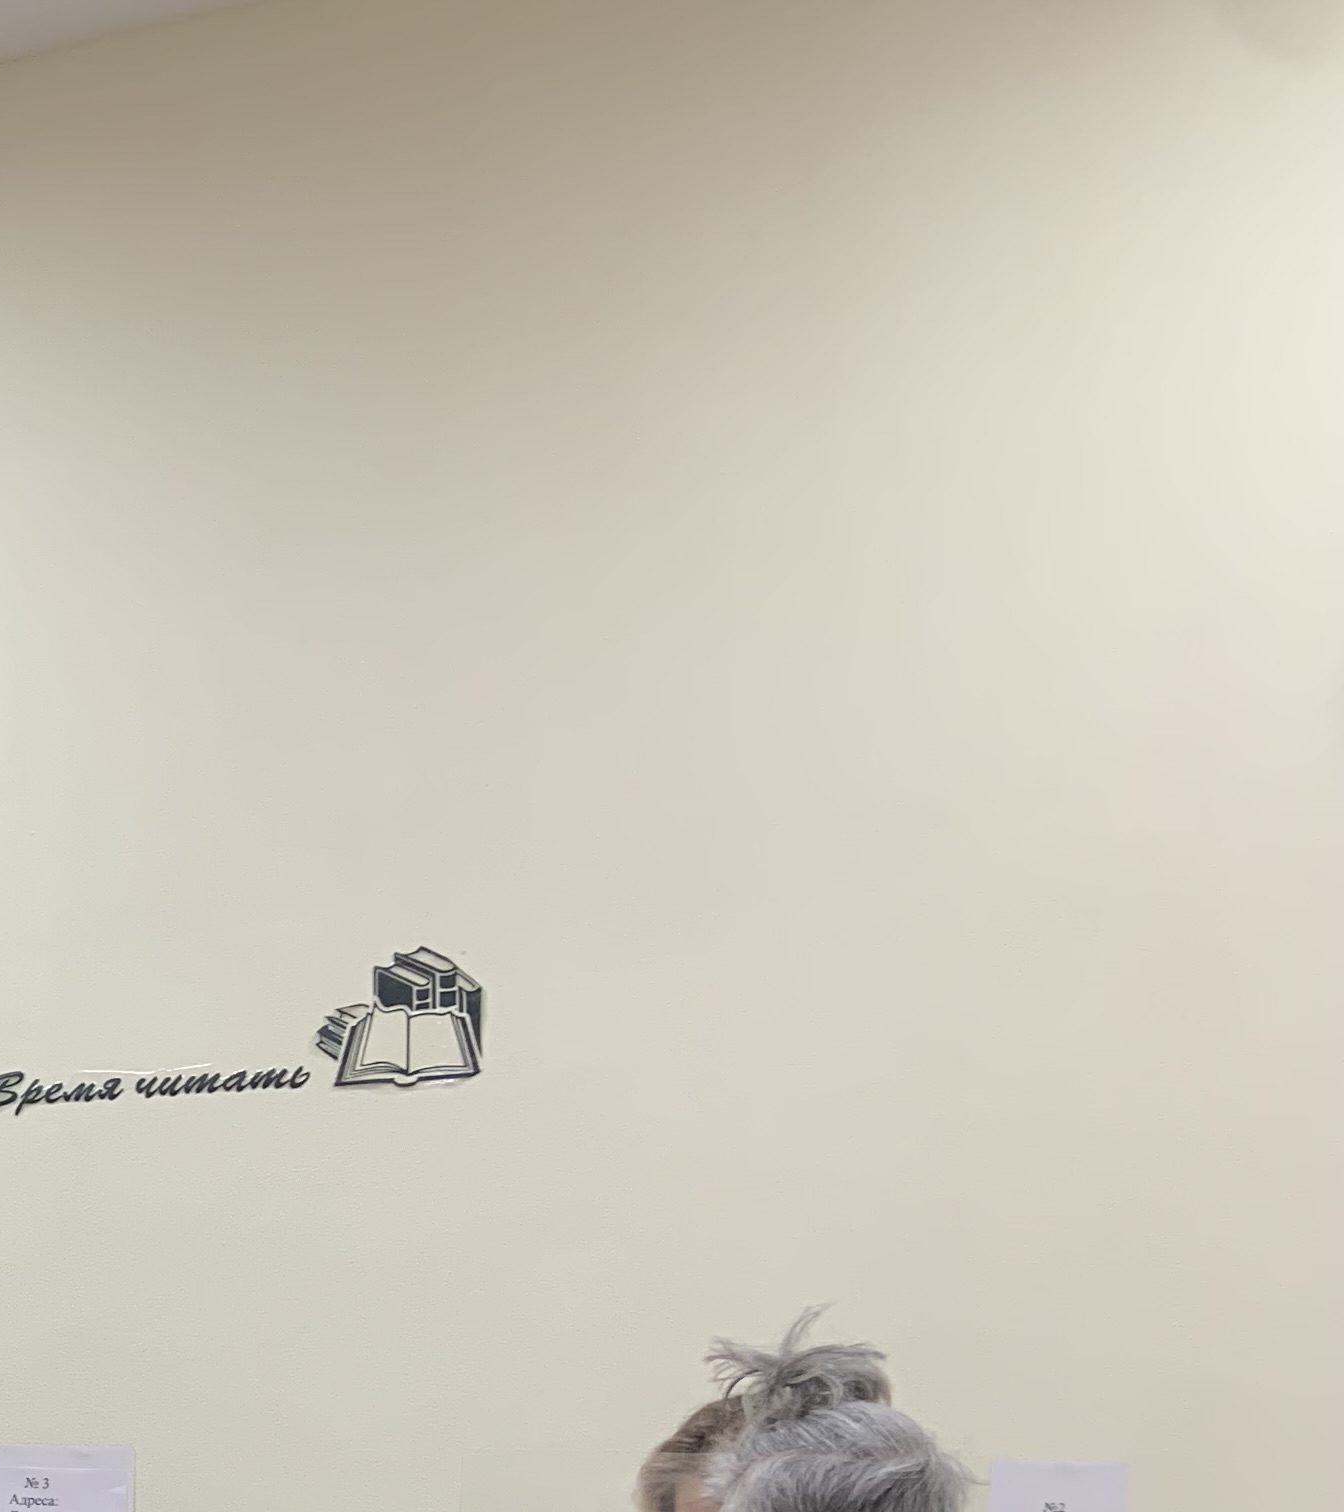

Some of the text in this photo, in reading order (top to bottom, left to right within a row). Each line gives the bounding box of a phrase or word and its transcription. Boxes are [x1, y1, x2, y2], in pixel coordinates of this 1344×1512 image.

[135, 1066, 310, 1099] читать
[24, 1477, 50, 1489] № 3
[9, 1494, 59, 1508] Адреса:
